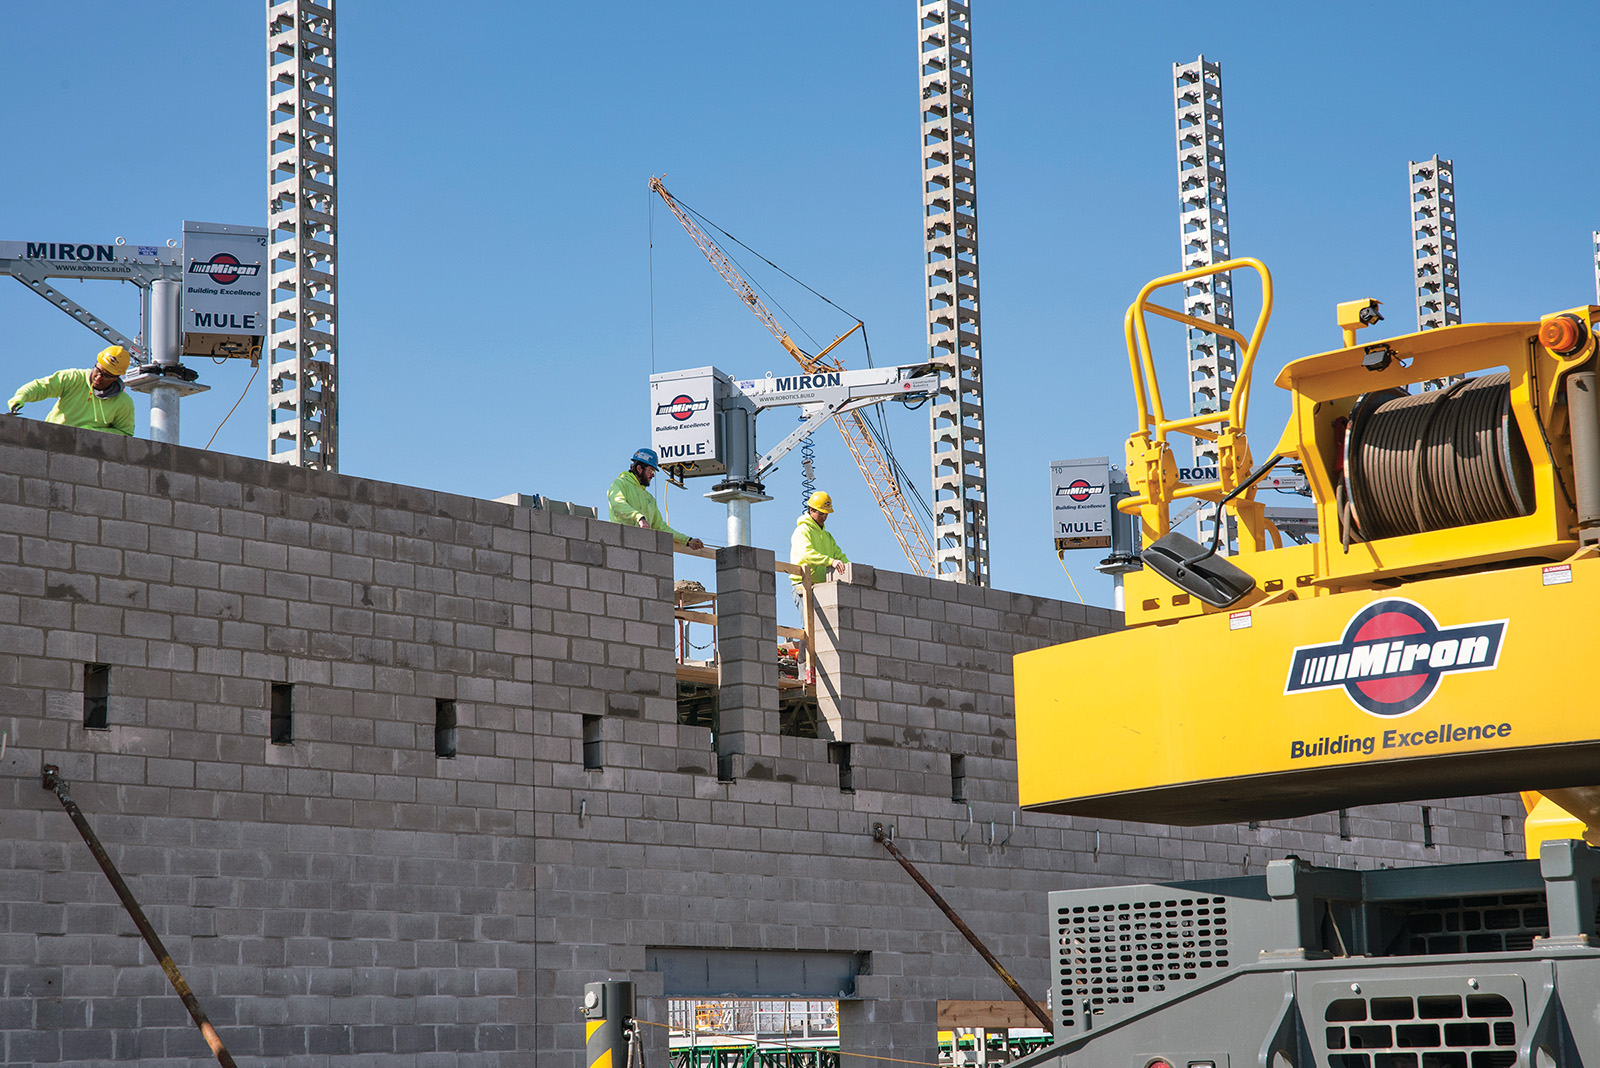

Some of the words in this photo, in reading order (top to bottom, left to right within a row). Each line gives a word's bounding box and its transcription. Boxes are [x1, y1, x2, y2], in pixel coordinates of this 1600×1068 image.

[26, 242, 114, 262] MIRON
[56, 265, 131, 273] WWW.ROBOTICS.BUILD
[210, 264, 256, 275] Miron
[188, 287, 218, 296] Building
[220, 288, 261, 296] Excellence
[195, 312, 255, 329] MULE
[776, 372, 840, 392] MIRON
[672, 402, 706, 412] Miron
[680, 422, 710, 430] Excellence
[660, 442, 706, 458] MULE
[1180, 467, 1217, 480] RON
[1070, 487, 1102, 495] Miron
[1061, 522, 1103, 533] MULE
[1346, 636, 1490, 678] Miron
[1290, 734, 1376, 759] Building
[1382, 722, 1512, 749] Excellence
